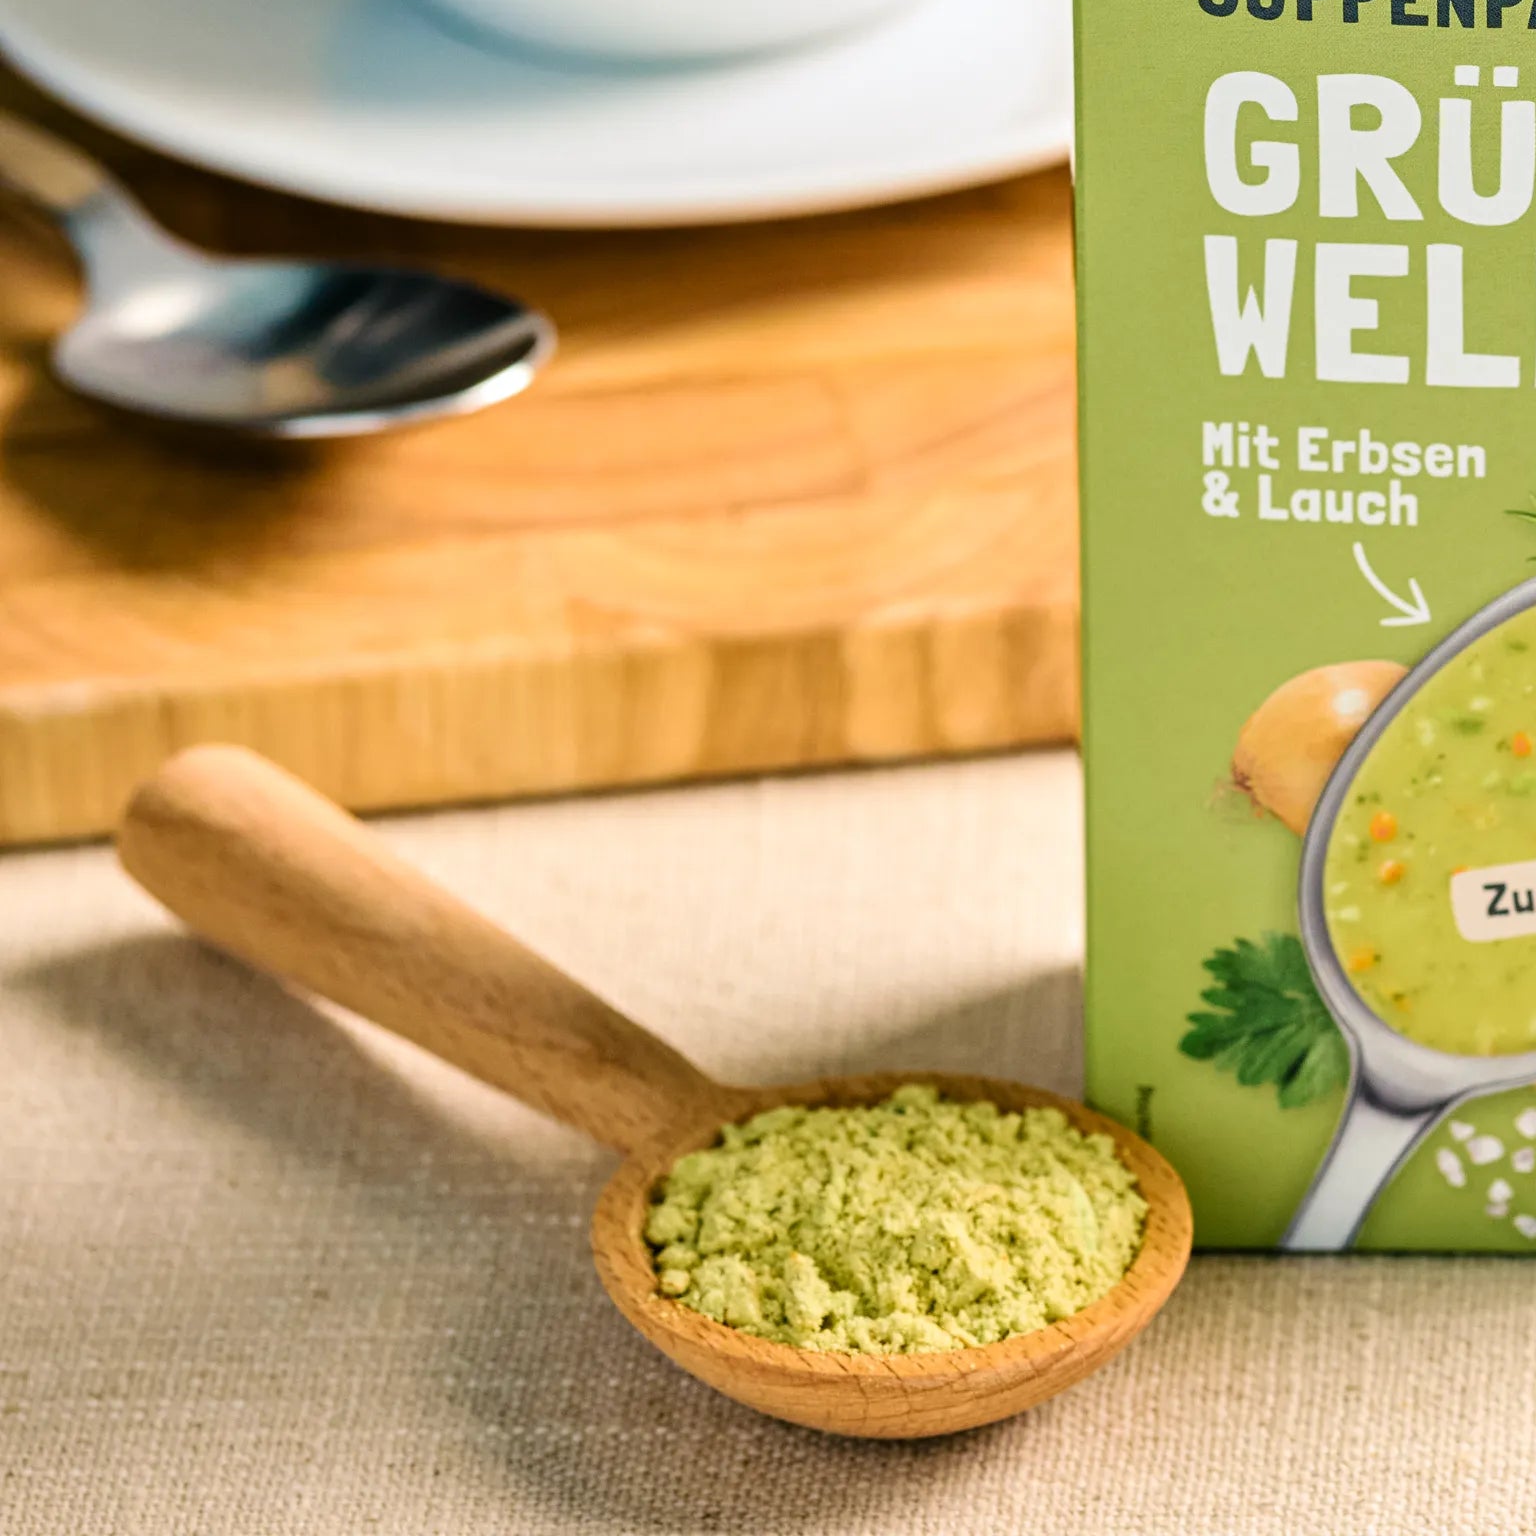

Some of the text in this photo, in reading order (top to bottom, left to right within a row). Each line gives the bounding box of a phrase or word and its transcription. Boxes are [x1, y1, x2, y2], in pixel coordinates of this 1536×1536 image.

[1202, 421, 1487, 478] Mit Erbsen
[1201, 470, 1418, 526] & Lauch
